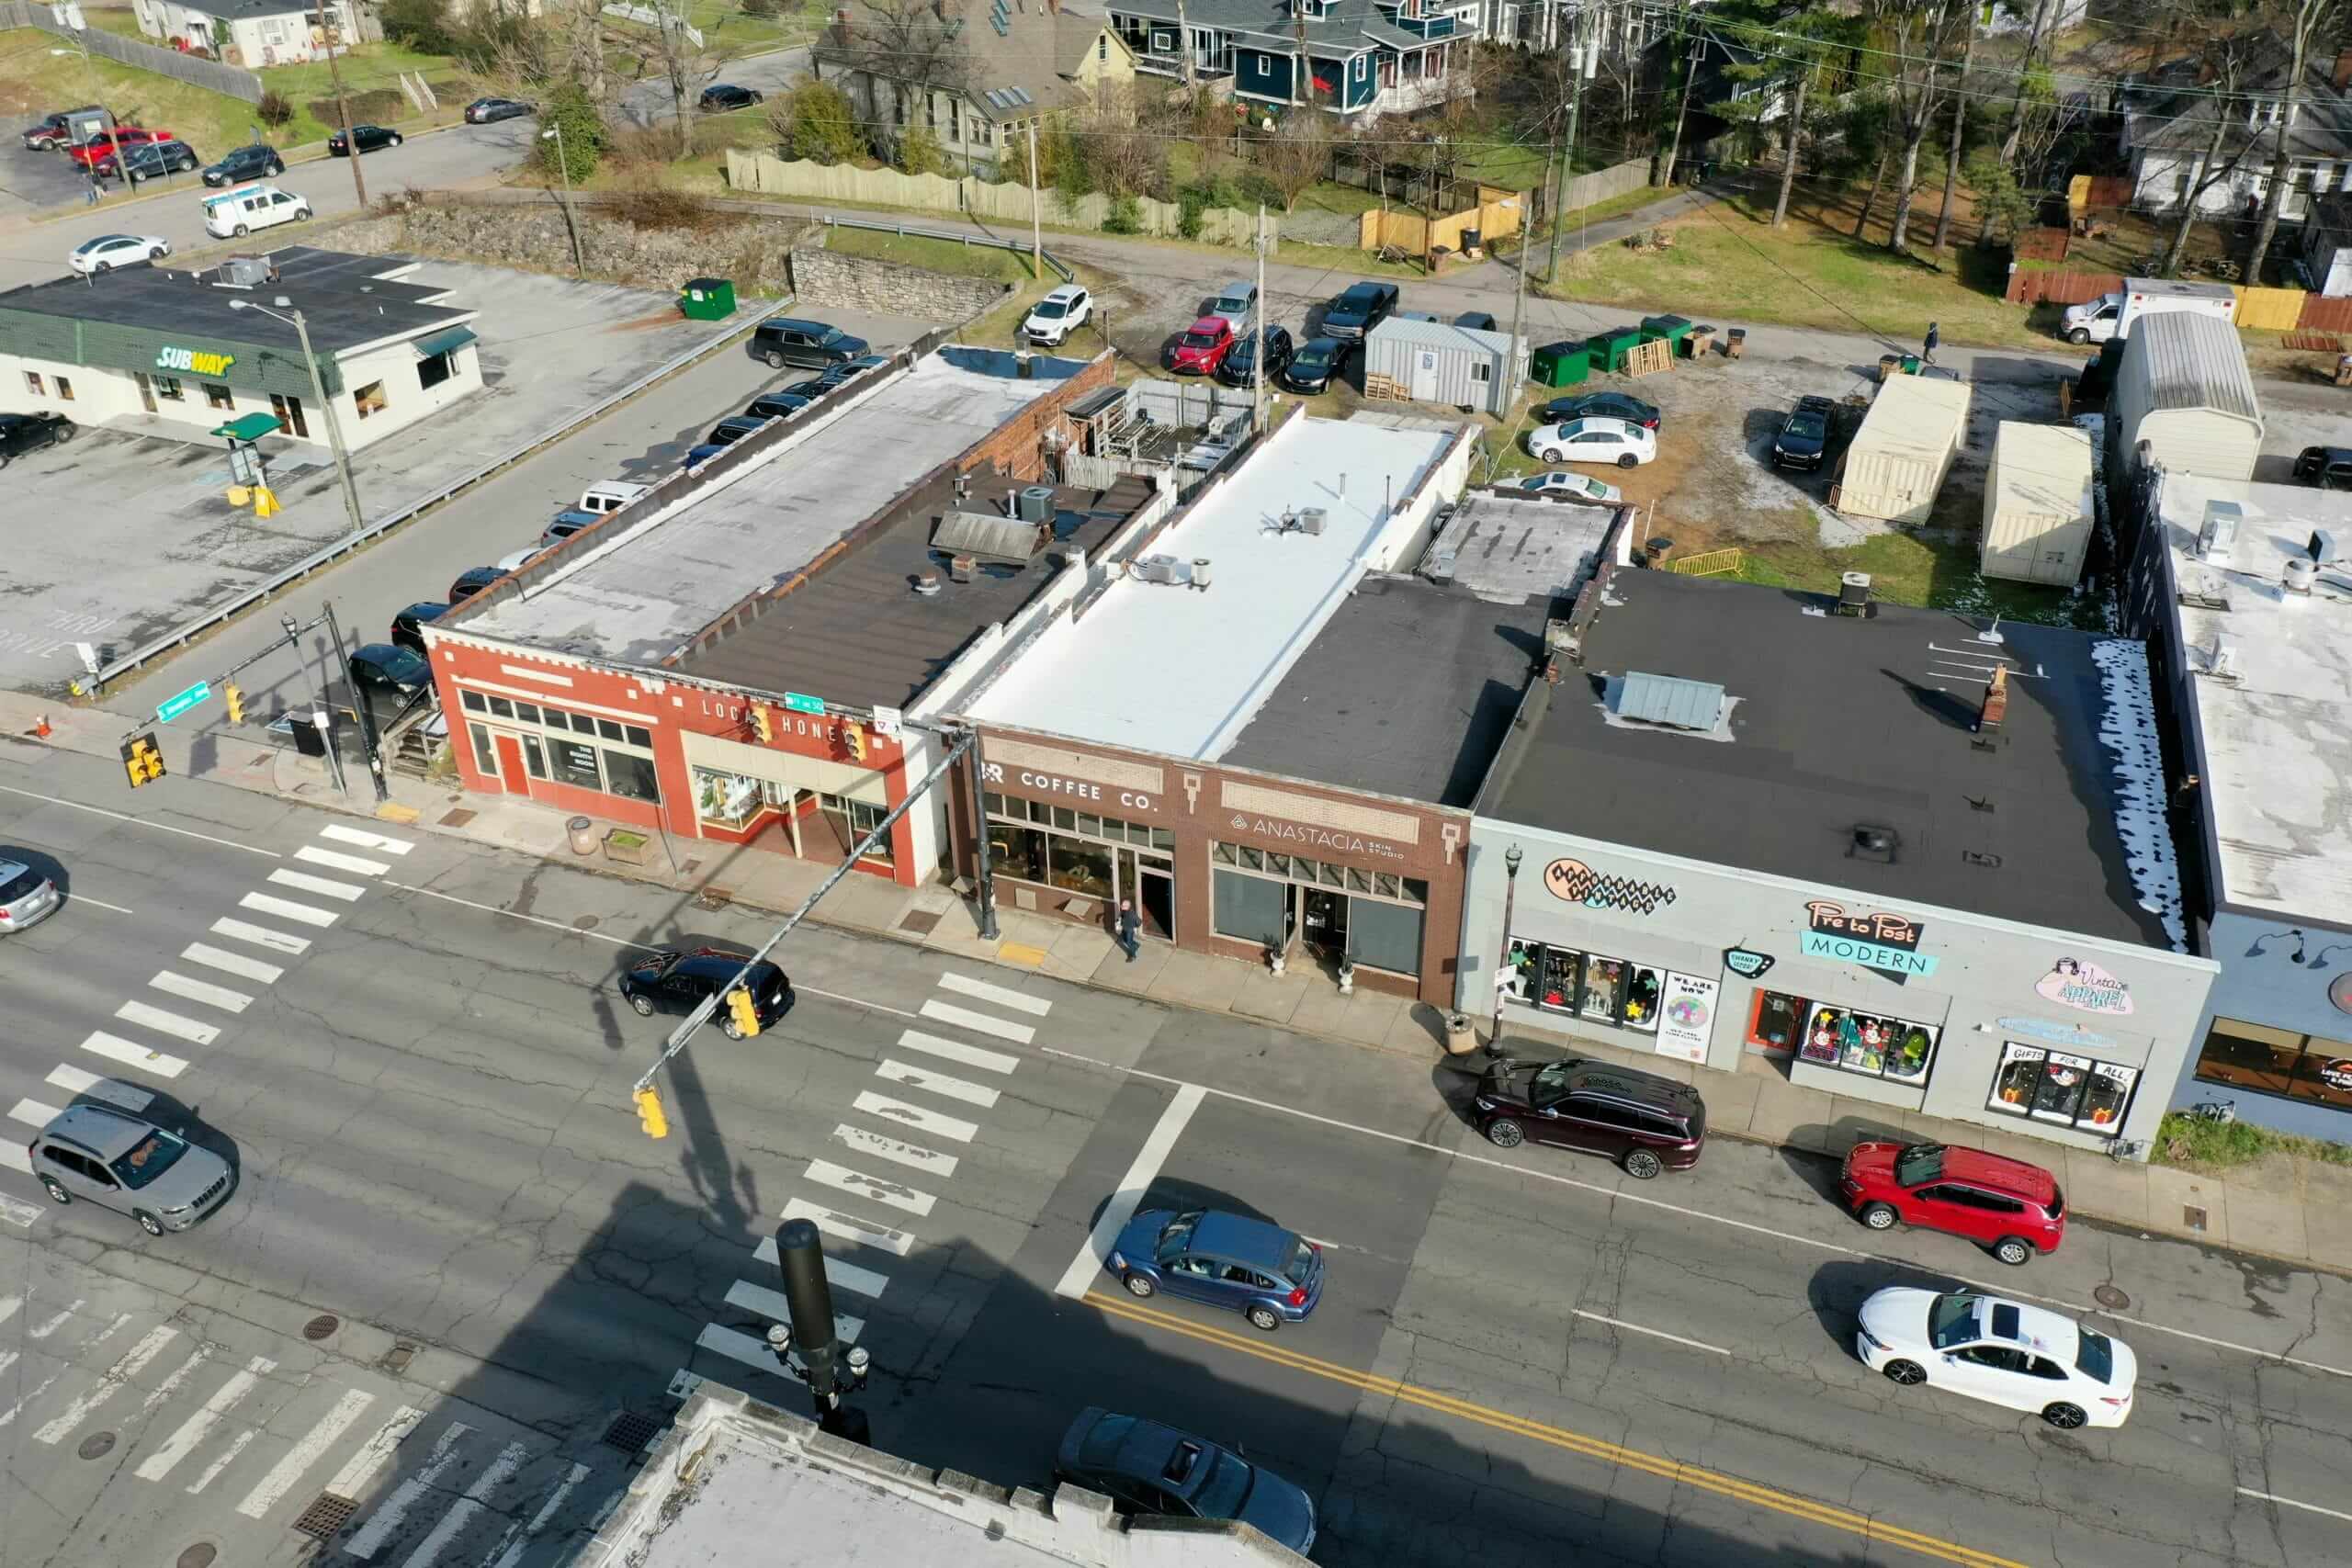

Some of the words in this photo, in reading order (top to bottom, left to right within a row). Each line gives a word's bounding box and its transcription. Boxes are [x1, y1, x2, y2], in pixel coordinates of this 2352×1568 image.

[156, 346, 235, 376] SUBWAY
[1021, 772, 1101, 800] COFFEE
[1121, 792, 1159, 812] CO.
[1253, 818, 1364, 853] ANASTACIA
[1368, 841, 1391, 851] SKIN
[1369, 848, 1405, 860] STUDIO
[1555, 866, 1674, 902] AFFORDABLE
[1570, 885, 1653, 912] VINTAGE
[1808, 901, 1845, 928] Pre
[1849, 919, 1870, 933] to
[1871, 912, 1915, 942] Post
[1811, 937, 1927, 973] MODERN
[1674, 976, 1689, 985] WE
[1692, 982, 1713, 990] ARE
[1680, 986, 1704, 995] NOW
[2081, 967, 2128, 991] Vintage
[2058, 983, 2126, 1011] APPAREL
[2059, 1055, 2078, 1066] FOR
